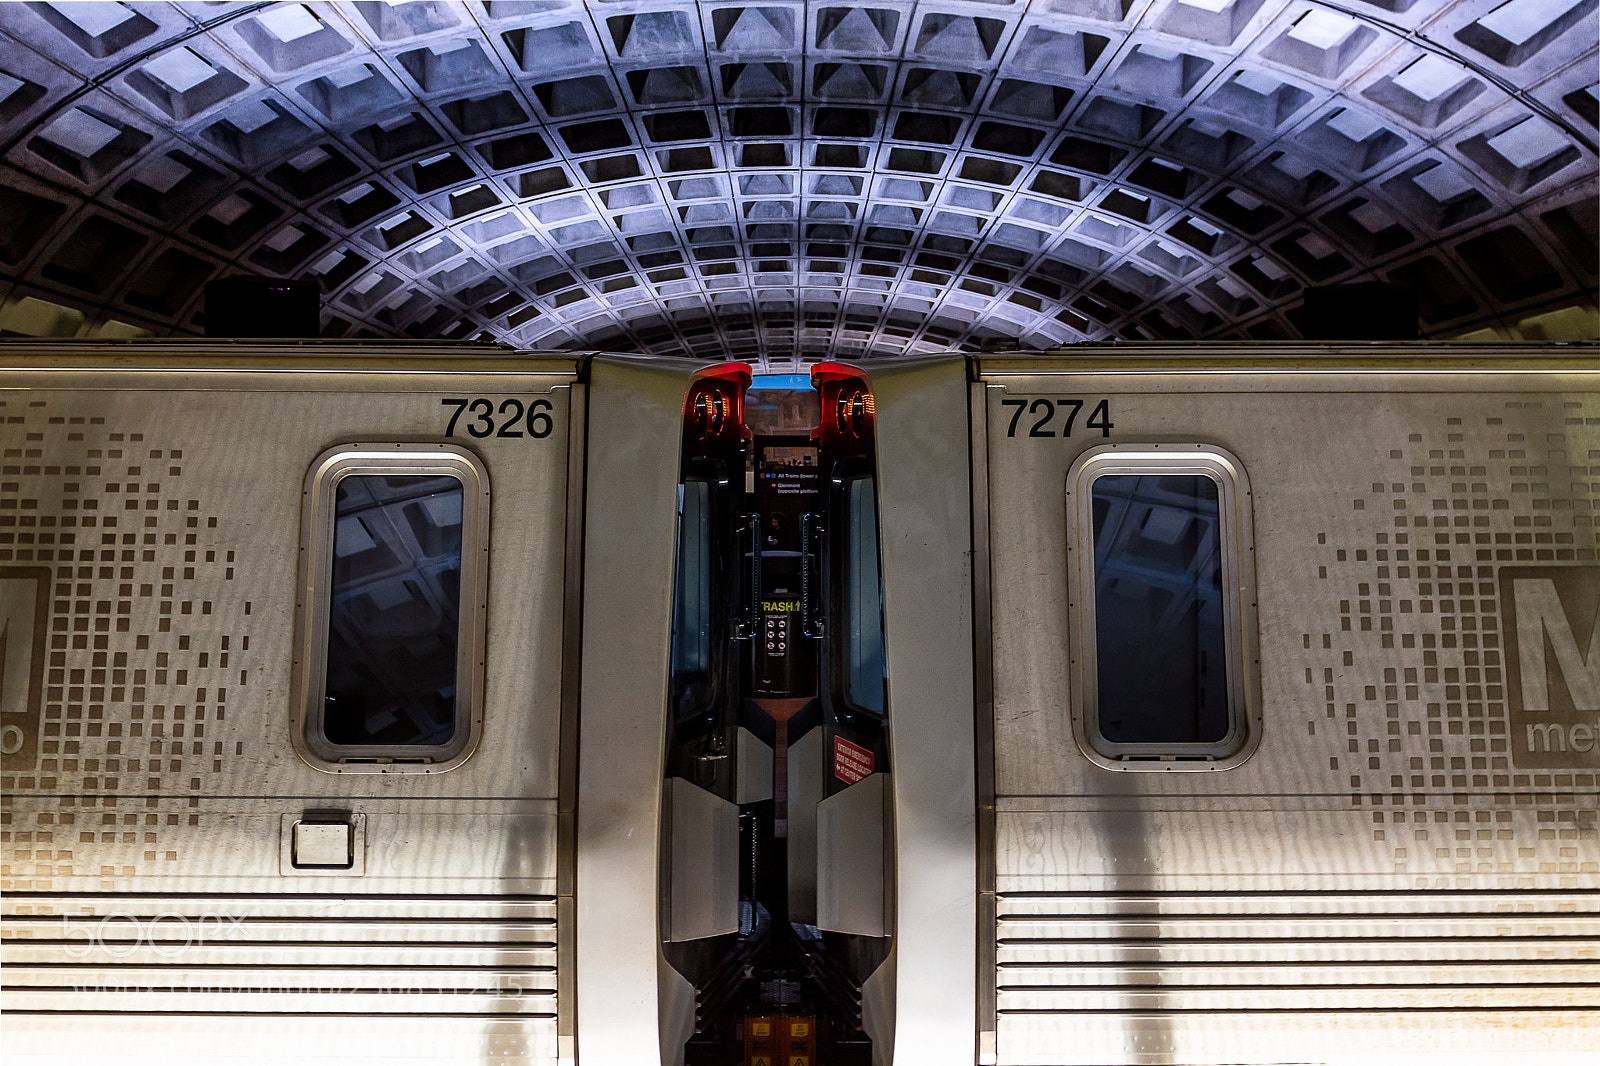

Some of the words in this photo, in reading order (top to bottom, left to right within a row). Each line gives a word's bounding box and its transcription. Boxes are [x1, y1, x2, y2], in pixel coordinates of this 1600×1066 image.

[441, 398, 553, 438] 7326
[1001, 398, 1114, 438] 7274
[1526, 722, 1600, 752] me
